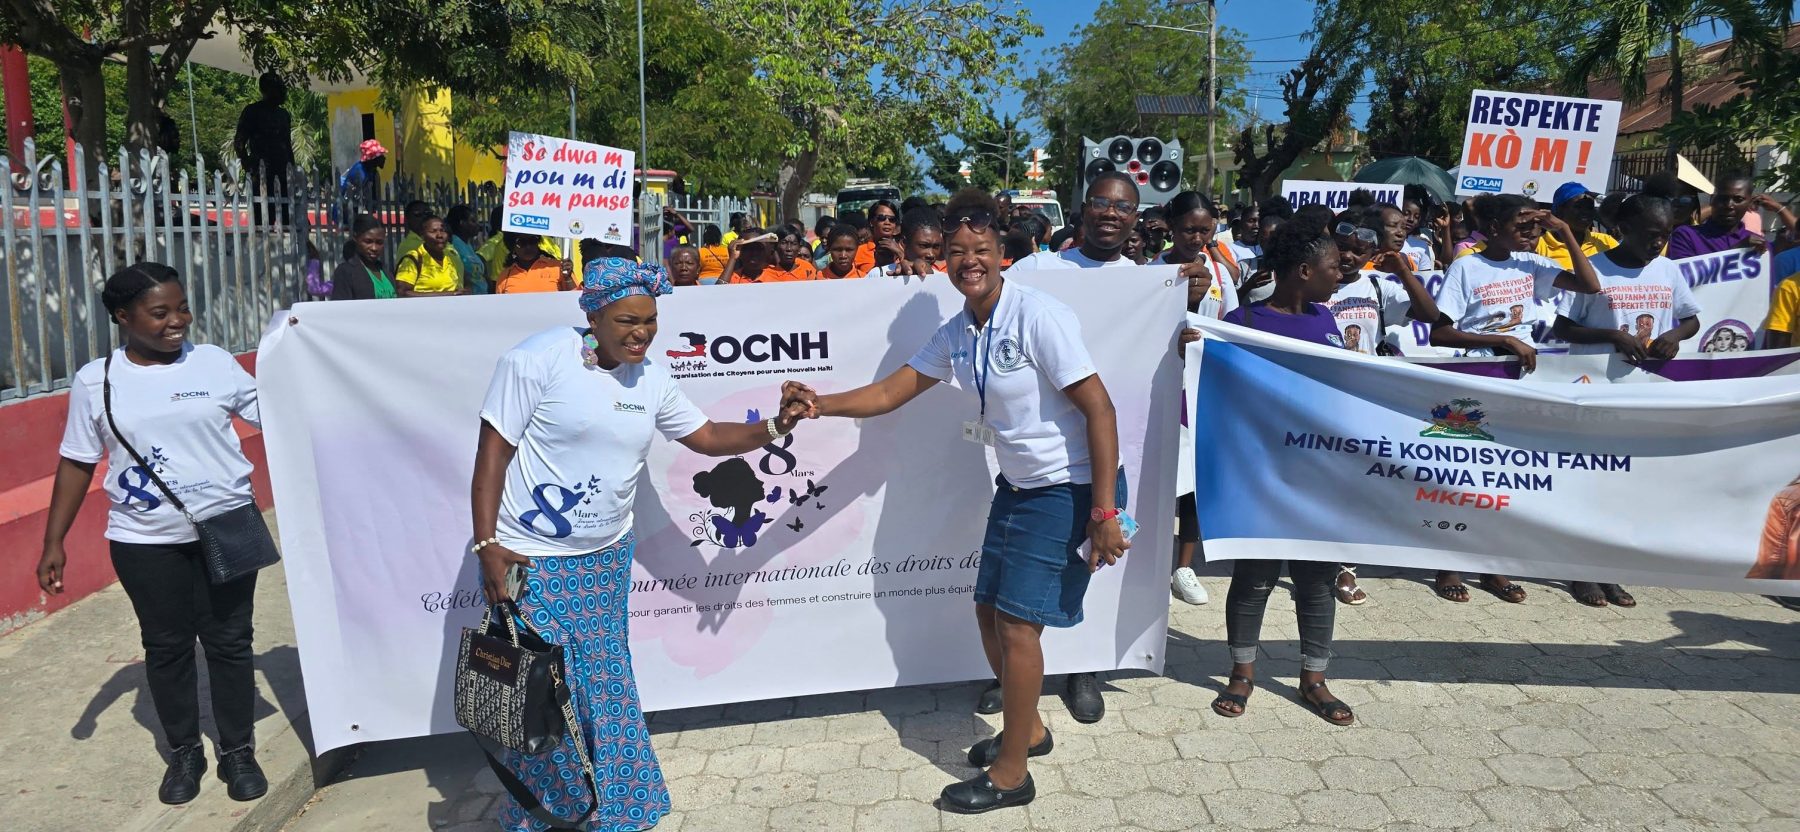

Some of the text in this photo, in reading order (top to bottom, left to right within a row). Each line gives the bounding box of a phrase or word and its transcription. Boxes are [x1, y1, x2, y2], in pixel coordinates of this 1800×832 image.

[1471, 95, 1603, 133] RESPEKTE
[522, 141, 623, 168] Se dwa m
[1467, 128, 1523, 169] KÒ
[1530, 137, 1569, 172] M
[514, 169, 627, 190] pou m di
[1478, 179, 1501, 187] PLAN
[508, 191, 630, 211] sa m panse
[526, 216, 548, 225] PLAN
[709, 331, 829, 364] OCNH
[671, 371, 711, 380] rganisation
[726, 370, 755, 378] Citoyens
[622, 403, 645, 412] OCNH
[759, 432, 797, 476] 8
[1284, 431, 1632, 473] MINISTÈ KONDISYON FANM
[790, 469, 815, 478] Mars
[1366, 462, 1553, 492] AK DWA FANM
[1415, 487, 1511, 511] MKFDF
[572, 509, 598, 518] Mars
[421, 550, 982, 613] Céléb ournée internationale des droits de
[653, 604, 693, 617] garantir
[696, 603, 711, 613] les
[713, 601, 743, 611] droits
[745, 597, 764, 608] des
[766, 594, 807, 607] femmes
[808, 593, 819, 603] et
[821, 589, 872, 602] construire
[874, 589, 886, 599] un
[888, 586, 923, 597] monde
[925, 585, 945, 597] plus
